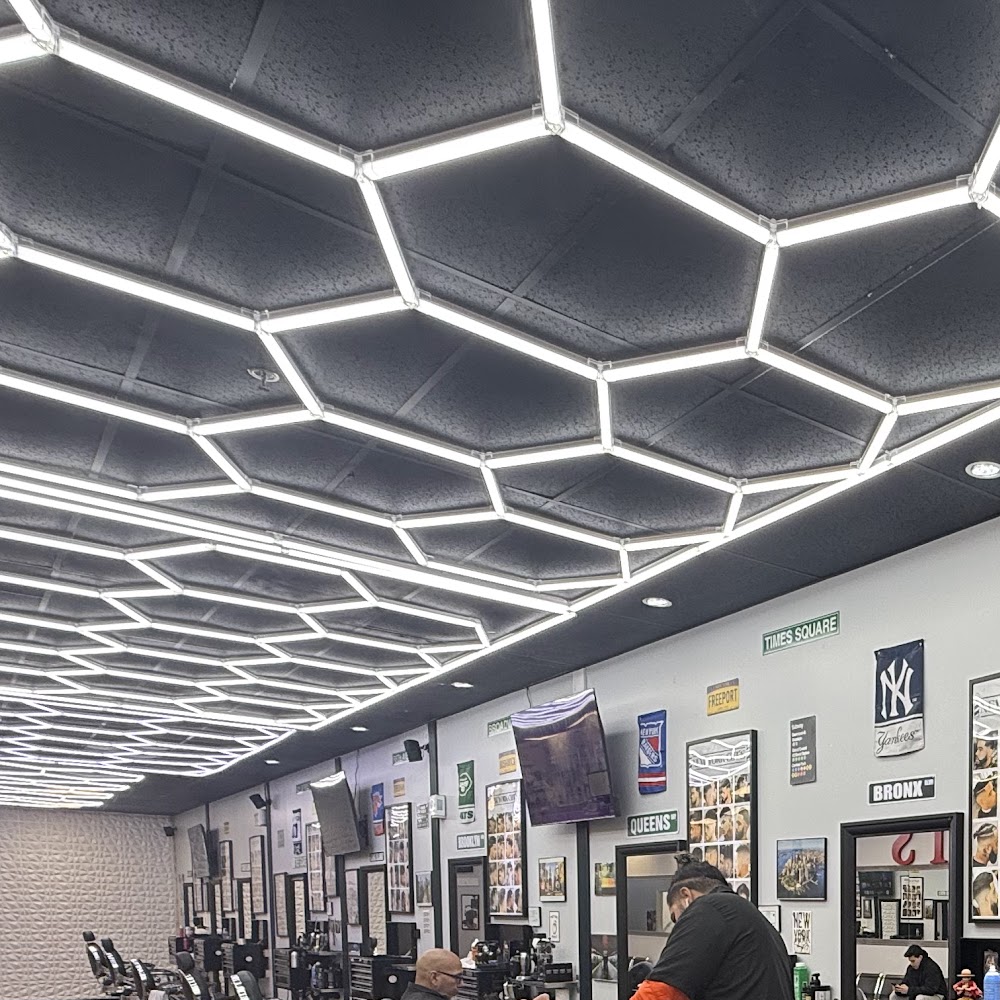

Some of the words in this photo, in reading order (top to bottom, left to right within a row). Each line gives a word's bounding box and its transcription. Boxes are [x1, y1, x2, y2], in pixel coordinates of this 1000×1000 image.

[764, 631, 793, 651] TIMES
[794, 616, 837, 642] SQUARE
[708, 688, 738, 708] FREEPORT
[879, 658, 915, 720] NY
[876, 726, 915, 755] Yankees
[873, 780, 924, 801] BRONX
[630, 813, 671, 836] QUEENS
